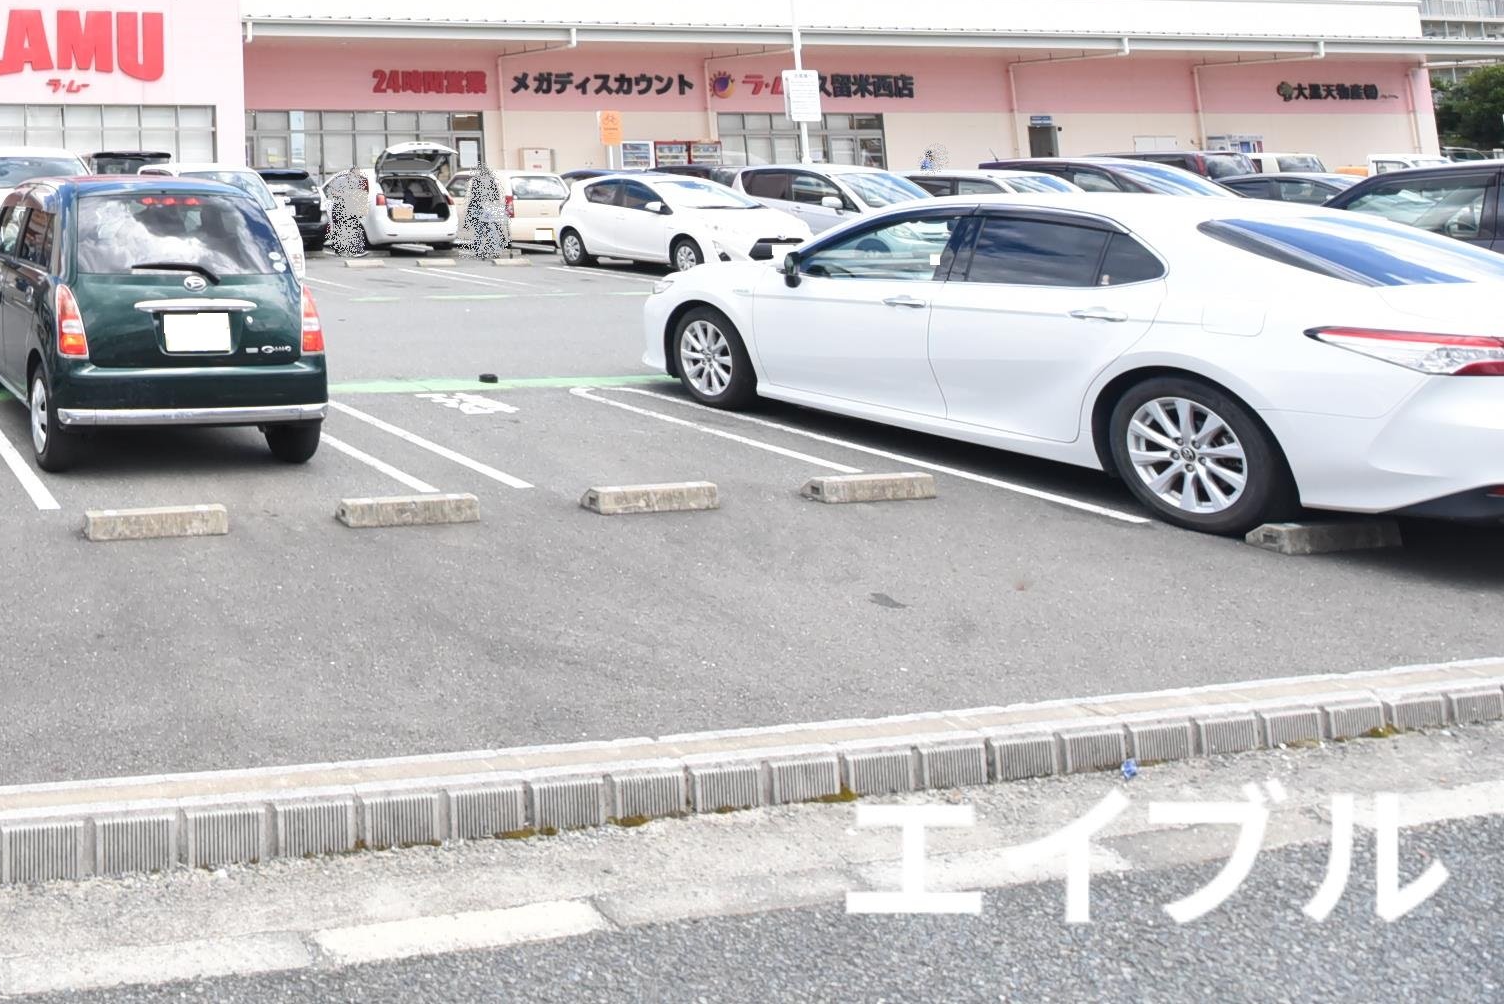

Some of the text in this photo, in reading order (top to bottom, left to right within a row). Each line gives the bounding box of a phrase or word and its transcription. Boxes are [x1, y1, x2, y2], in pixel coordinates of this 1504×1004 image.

[372, 69, 487, 94] 24時間営業
[511, 72, 694, 95] メガディスカウント
